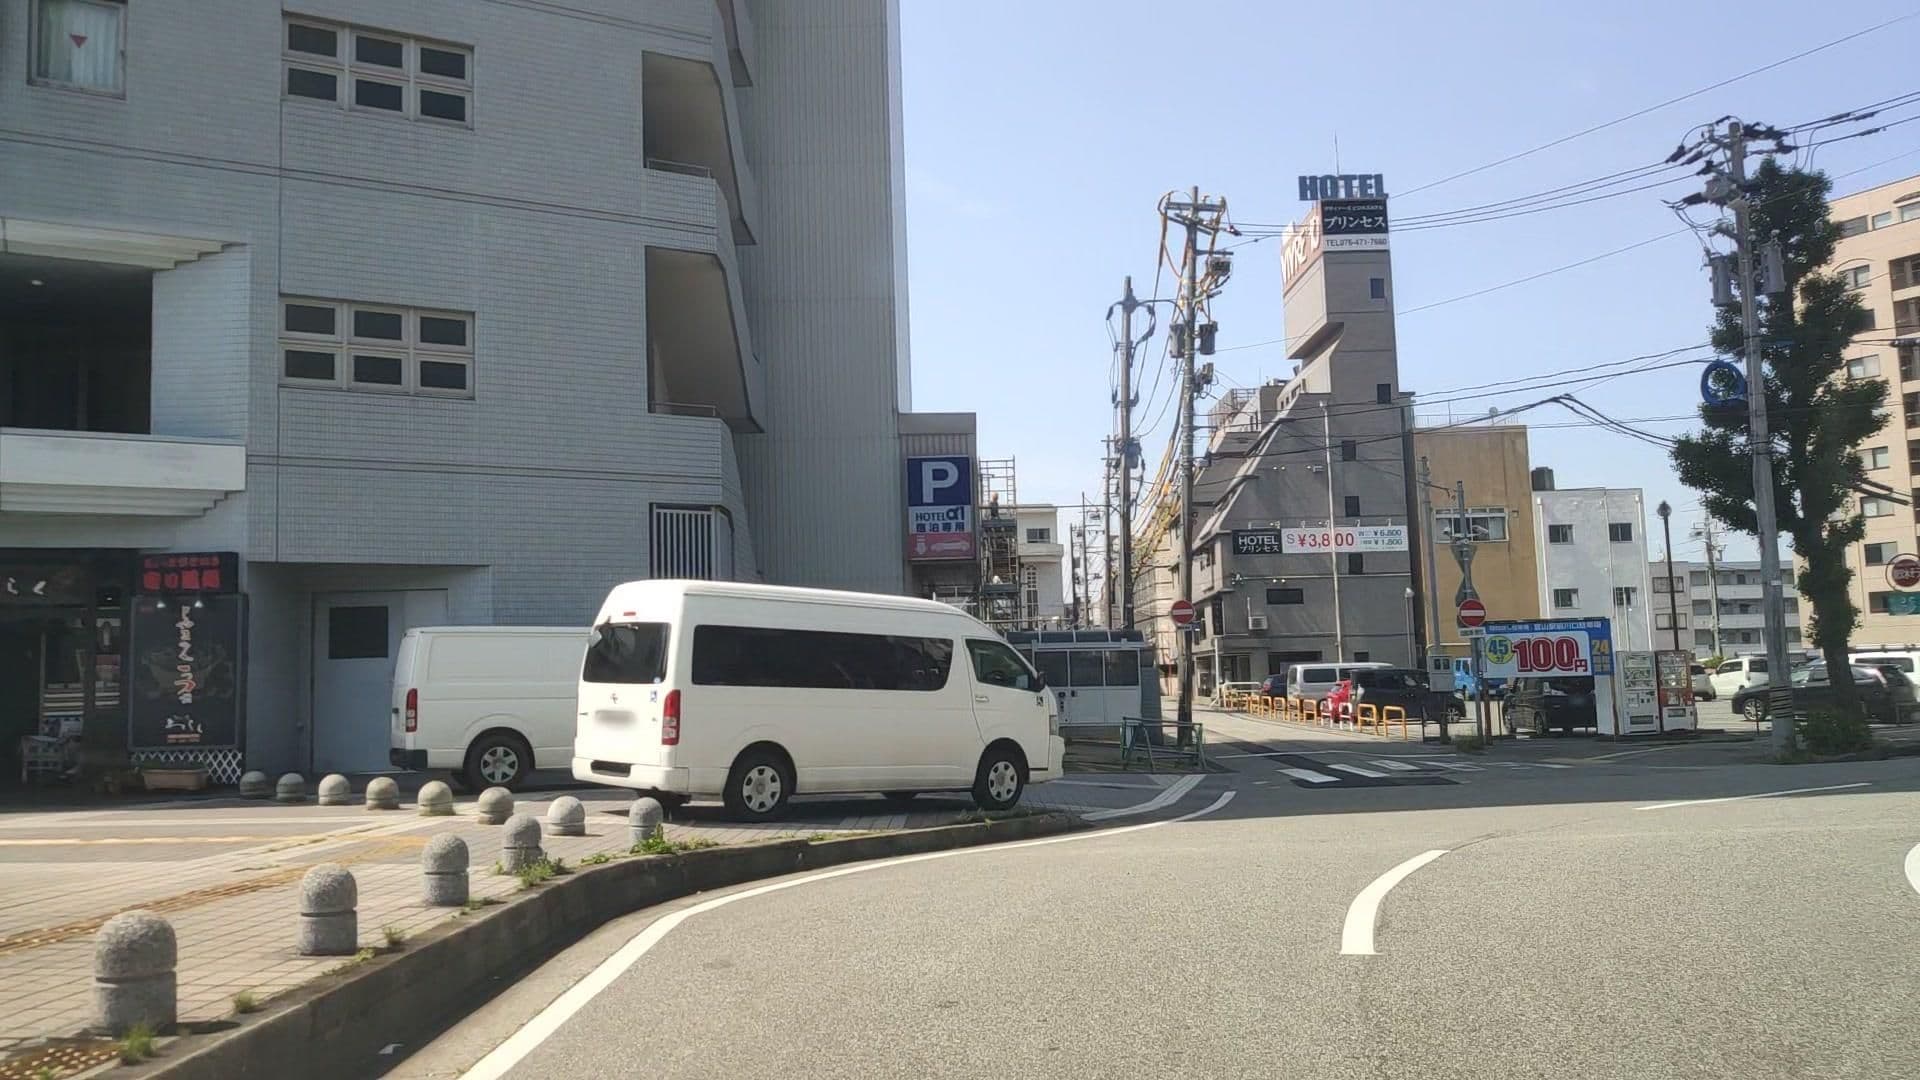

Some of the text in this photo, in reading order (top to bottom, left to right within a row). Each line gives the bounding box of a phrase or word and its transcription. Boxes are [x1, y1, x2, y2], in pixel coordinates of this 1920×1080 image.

[1298, 173, 1388, 200] HOTEL
[1324, 215, 1385, 231] プリンセス
[921, 461, 959, 504] P
[915, 512, 945, 522] HOTEL
[1238, 535, 1279, 545] HOTEL
[1286, 533, 1354, 548] S ¥3,800
[1239, 545, 1280, 553] プリンセス
[1488, 640, 1509, 655] 45
[1512, 636, 1588, 673] 100円
[1592, 639, 1610, 655] 24
